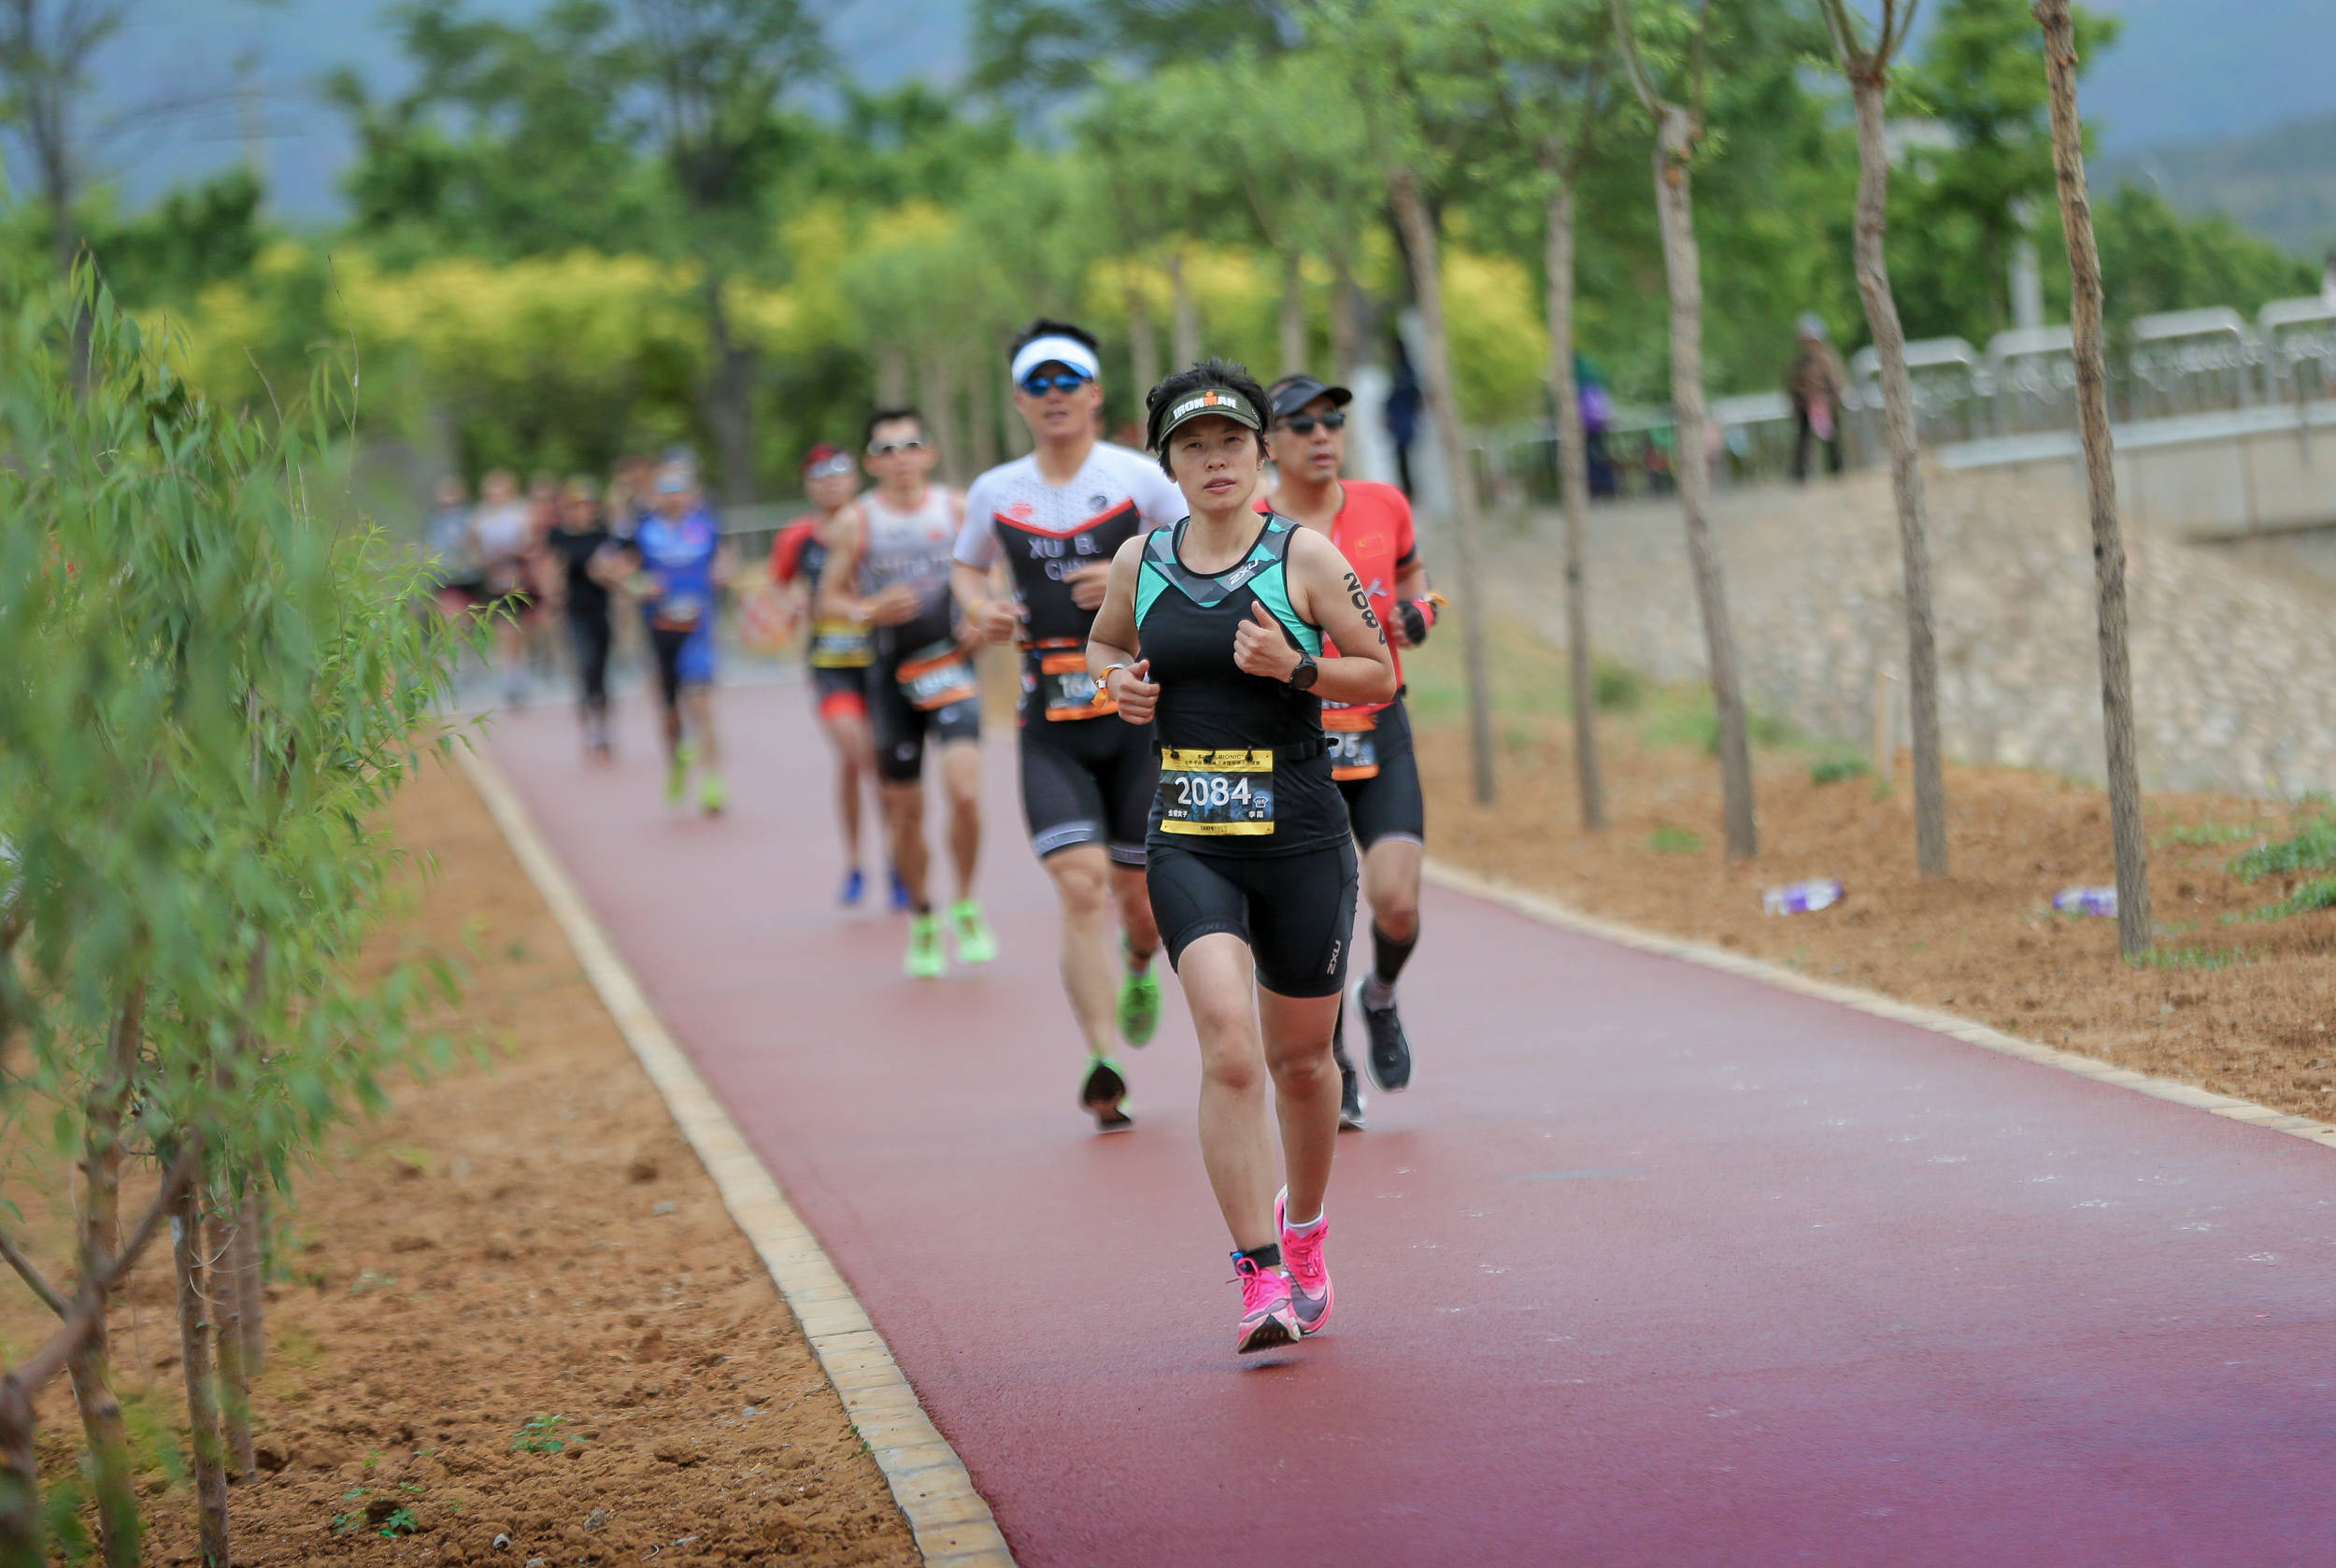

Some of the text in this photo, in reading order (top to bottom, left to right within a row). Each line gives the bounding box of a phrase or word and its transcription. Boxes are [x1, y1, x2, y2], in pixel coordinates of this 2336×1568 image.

[1173, 390, 1237, 420] IRONMAN
[1027, 536, 1065, 559] XU
[1229, 558, 1259, 585] 2XU
[1175, 777, 1252, 806] 2084
[1326, 939, 1341, 976] 2XU
